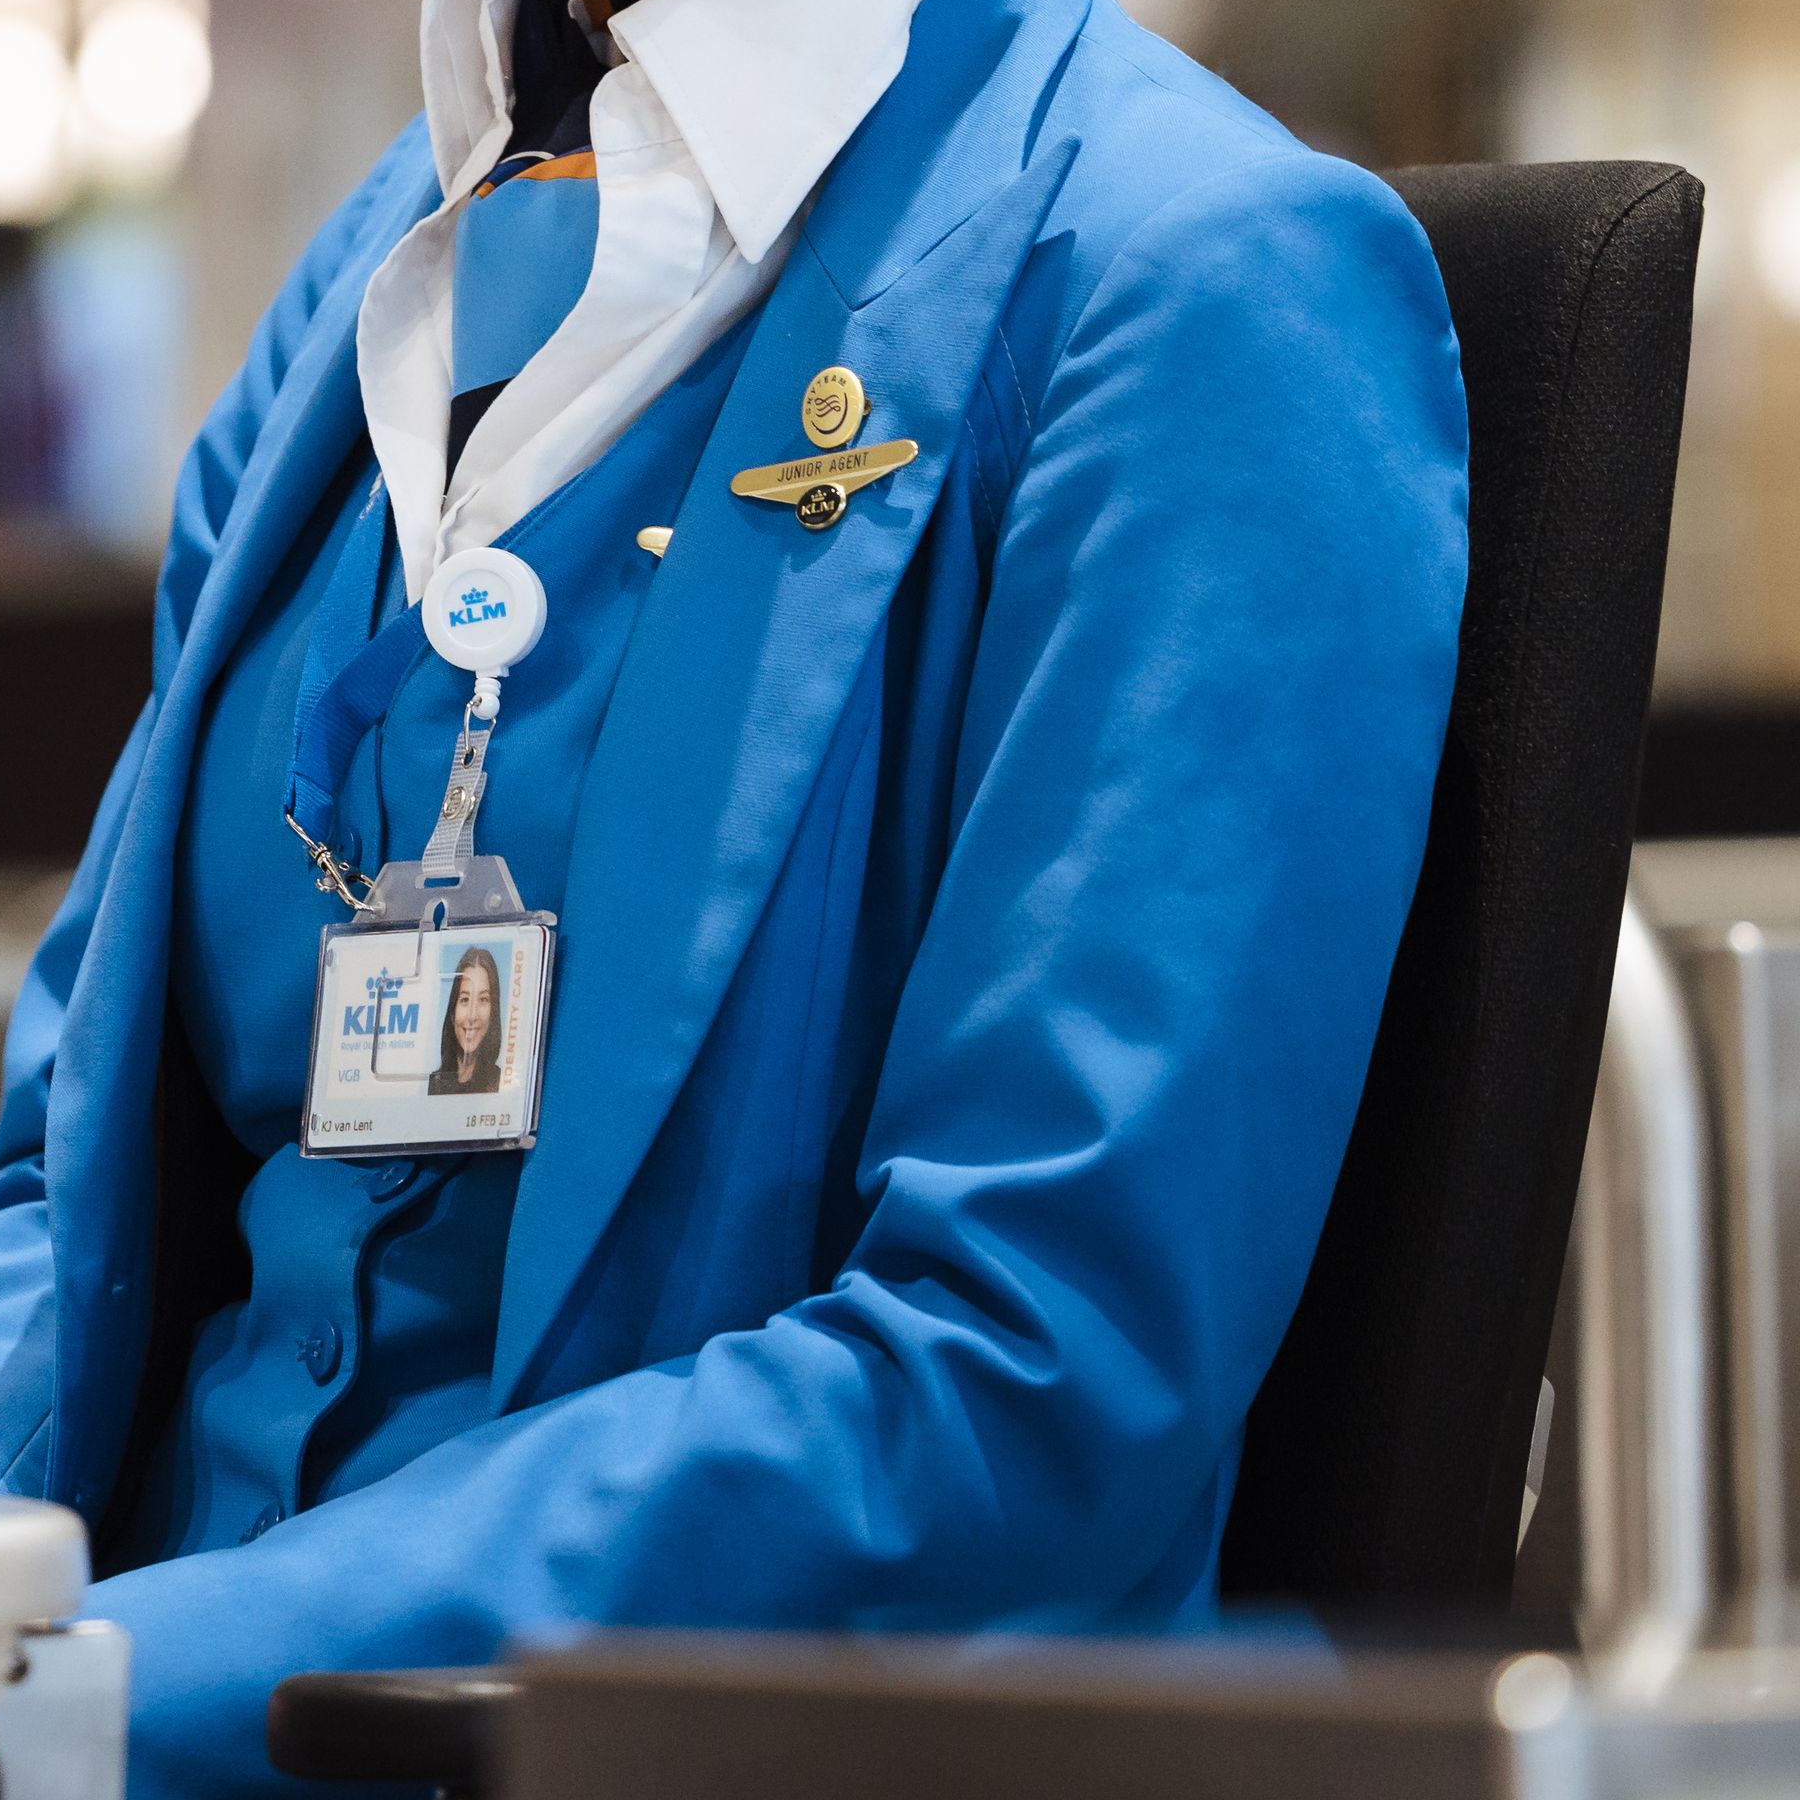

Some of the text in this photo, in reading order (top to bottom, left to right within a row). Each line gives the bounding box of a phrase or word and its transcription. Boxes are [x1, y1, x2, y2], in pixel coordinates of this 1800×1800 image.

[805, 374, 847, 415] SKYTEAM
[777, 451, 869, 482] JUNIOR AGENT
[801, 500, 835, 516] KLM
[449, 601, 507, 628] KLM
[342, 1003, 420, 1036] KLM
[504, 950, 525, 1085] IDENTITY CARD
[363, 1041, 387, 1050] Duch
[338, 1068, 360, 1082] VGB
[321, 1119, 373, 1132] KJ van Lent
[466, 1113, 511, 1127] 18 FEB 23
